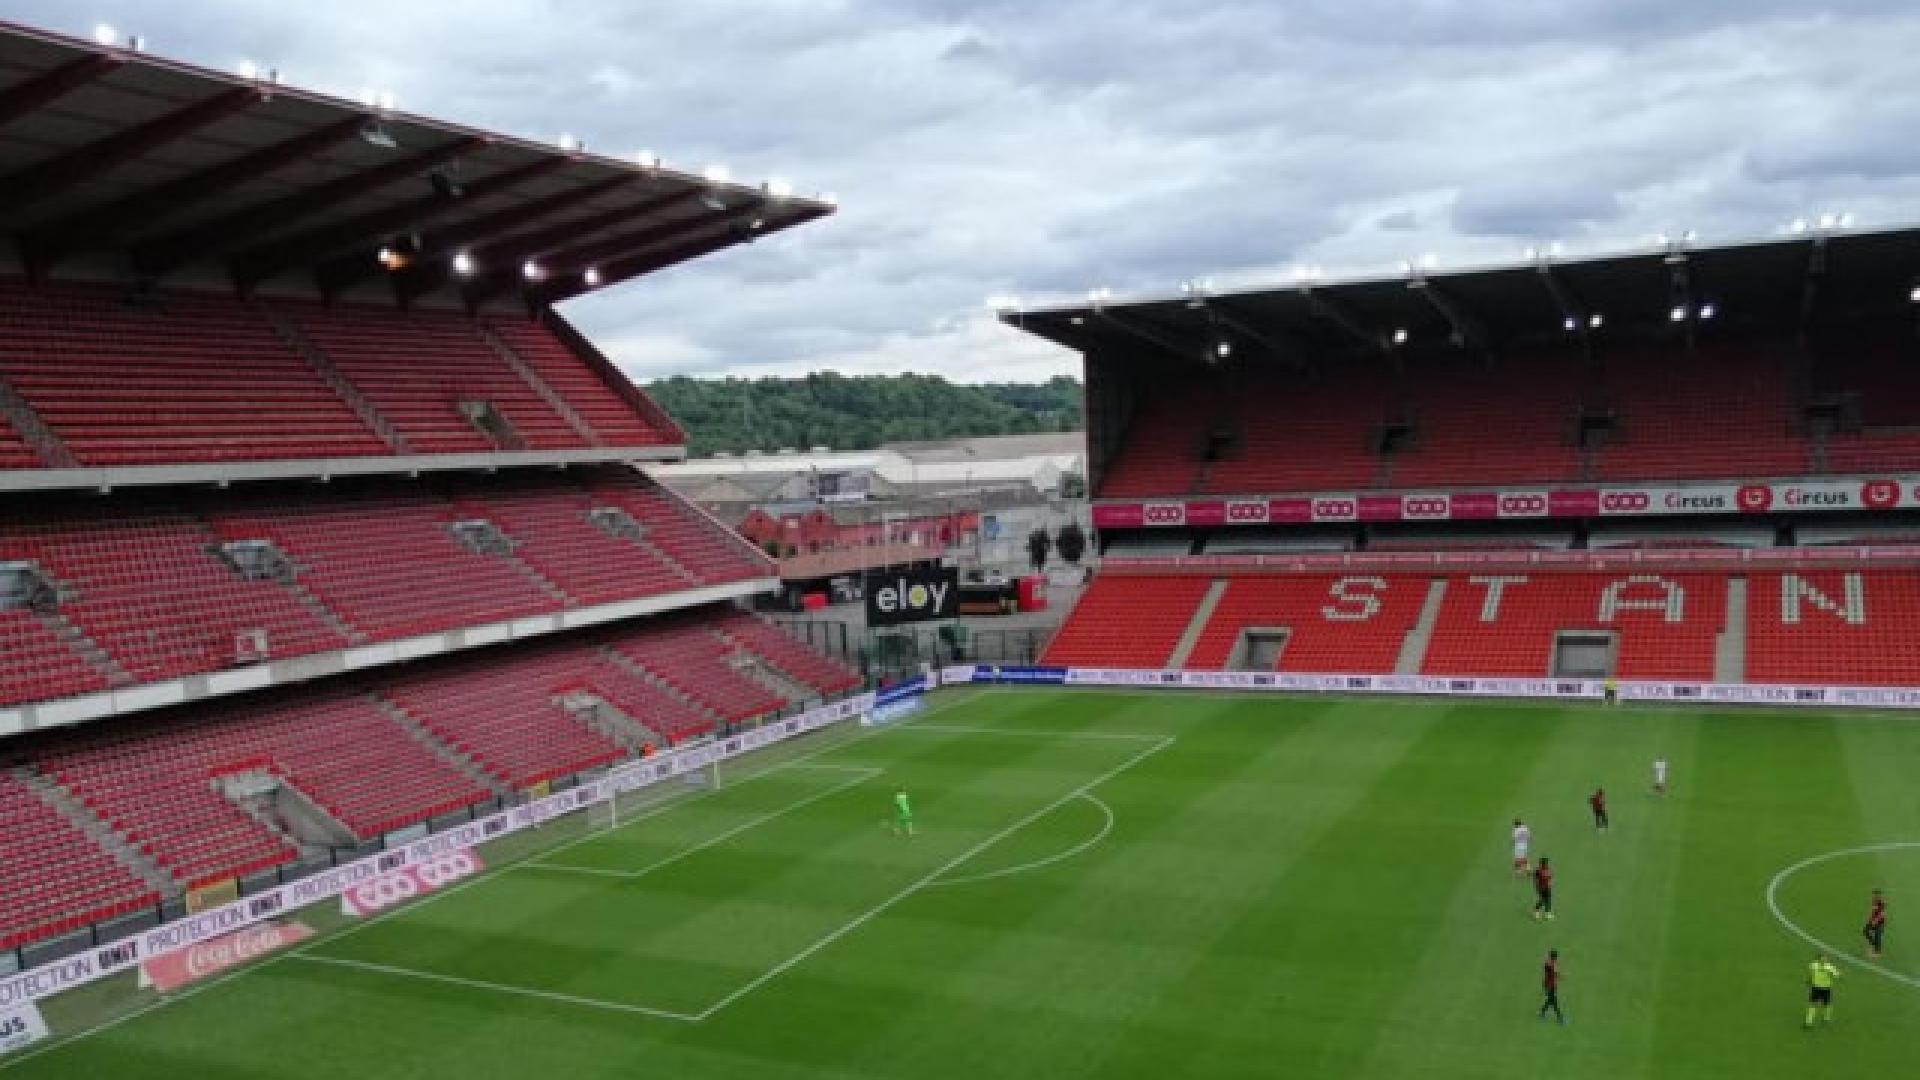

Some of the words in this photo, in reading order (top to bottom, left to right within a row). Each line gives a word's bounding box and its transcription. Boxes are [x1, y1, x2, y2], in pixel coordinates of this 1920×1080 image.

[1664, 491, 1726, 510] Circus
[1784, 487, 1849, 506] Circus
[876, 577, 948, 616] eloy
